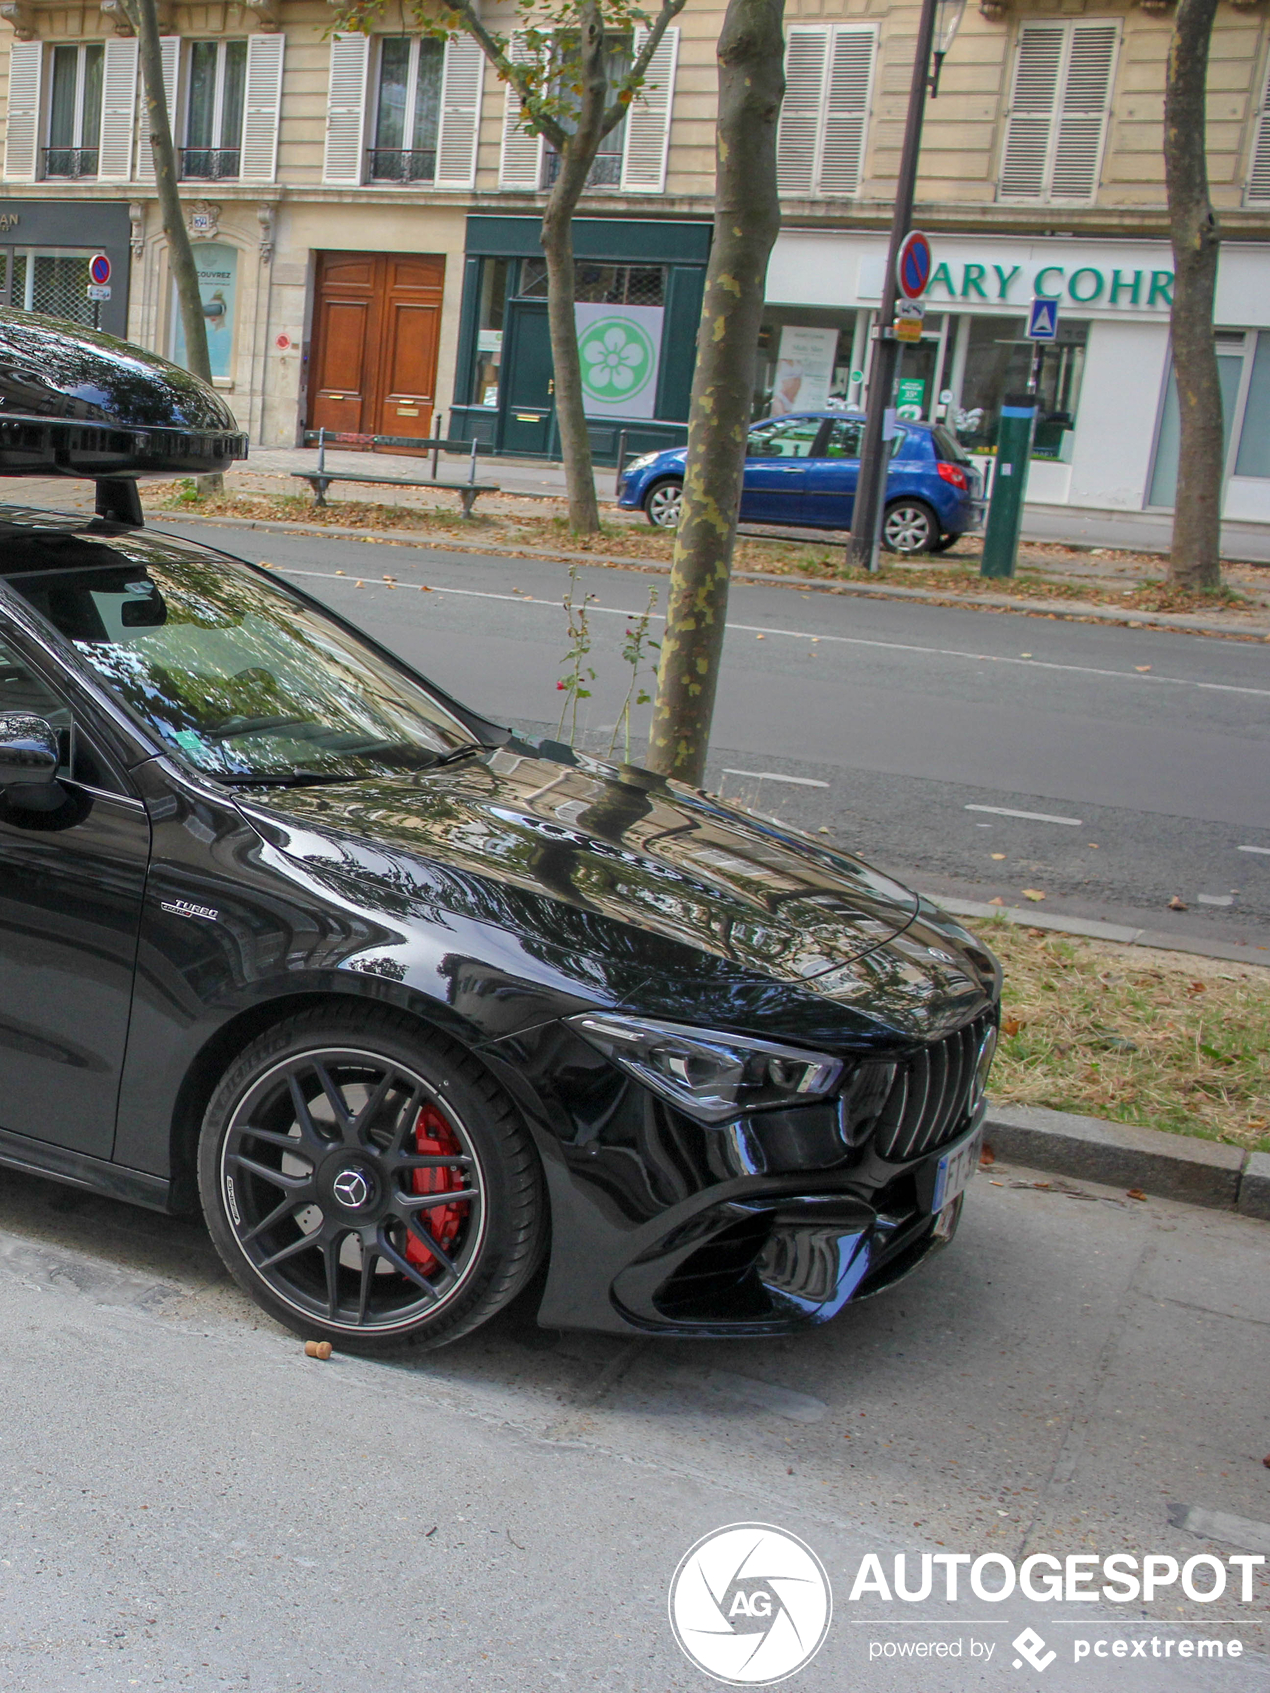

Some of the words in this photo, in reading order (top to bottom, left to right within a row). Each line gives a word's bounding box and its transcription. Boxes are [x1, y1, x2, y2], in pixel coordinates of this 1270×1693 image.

[924, 262, 1022, 299] ARY
[1033, 266, 1176, 306] COHR
[175, 899, 219, 917] TURBO
